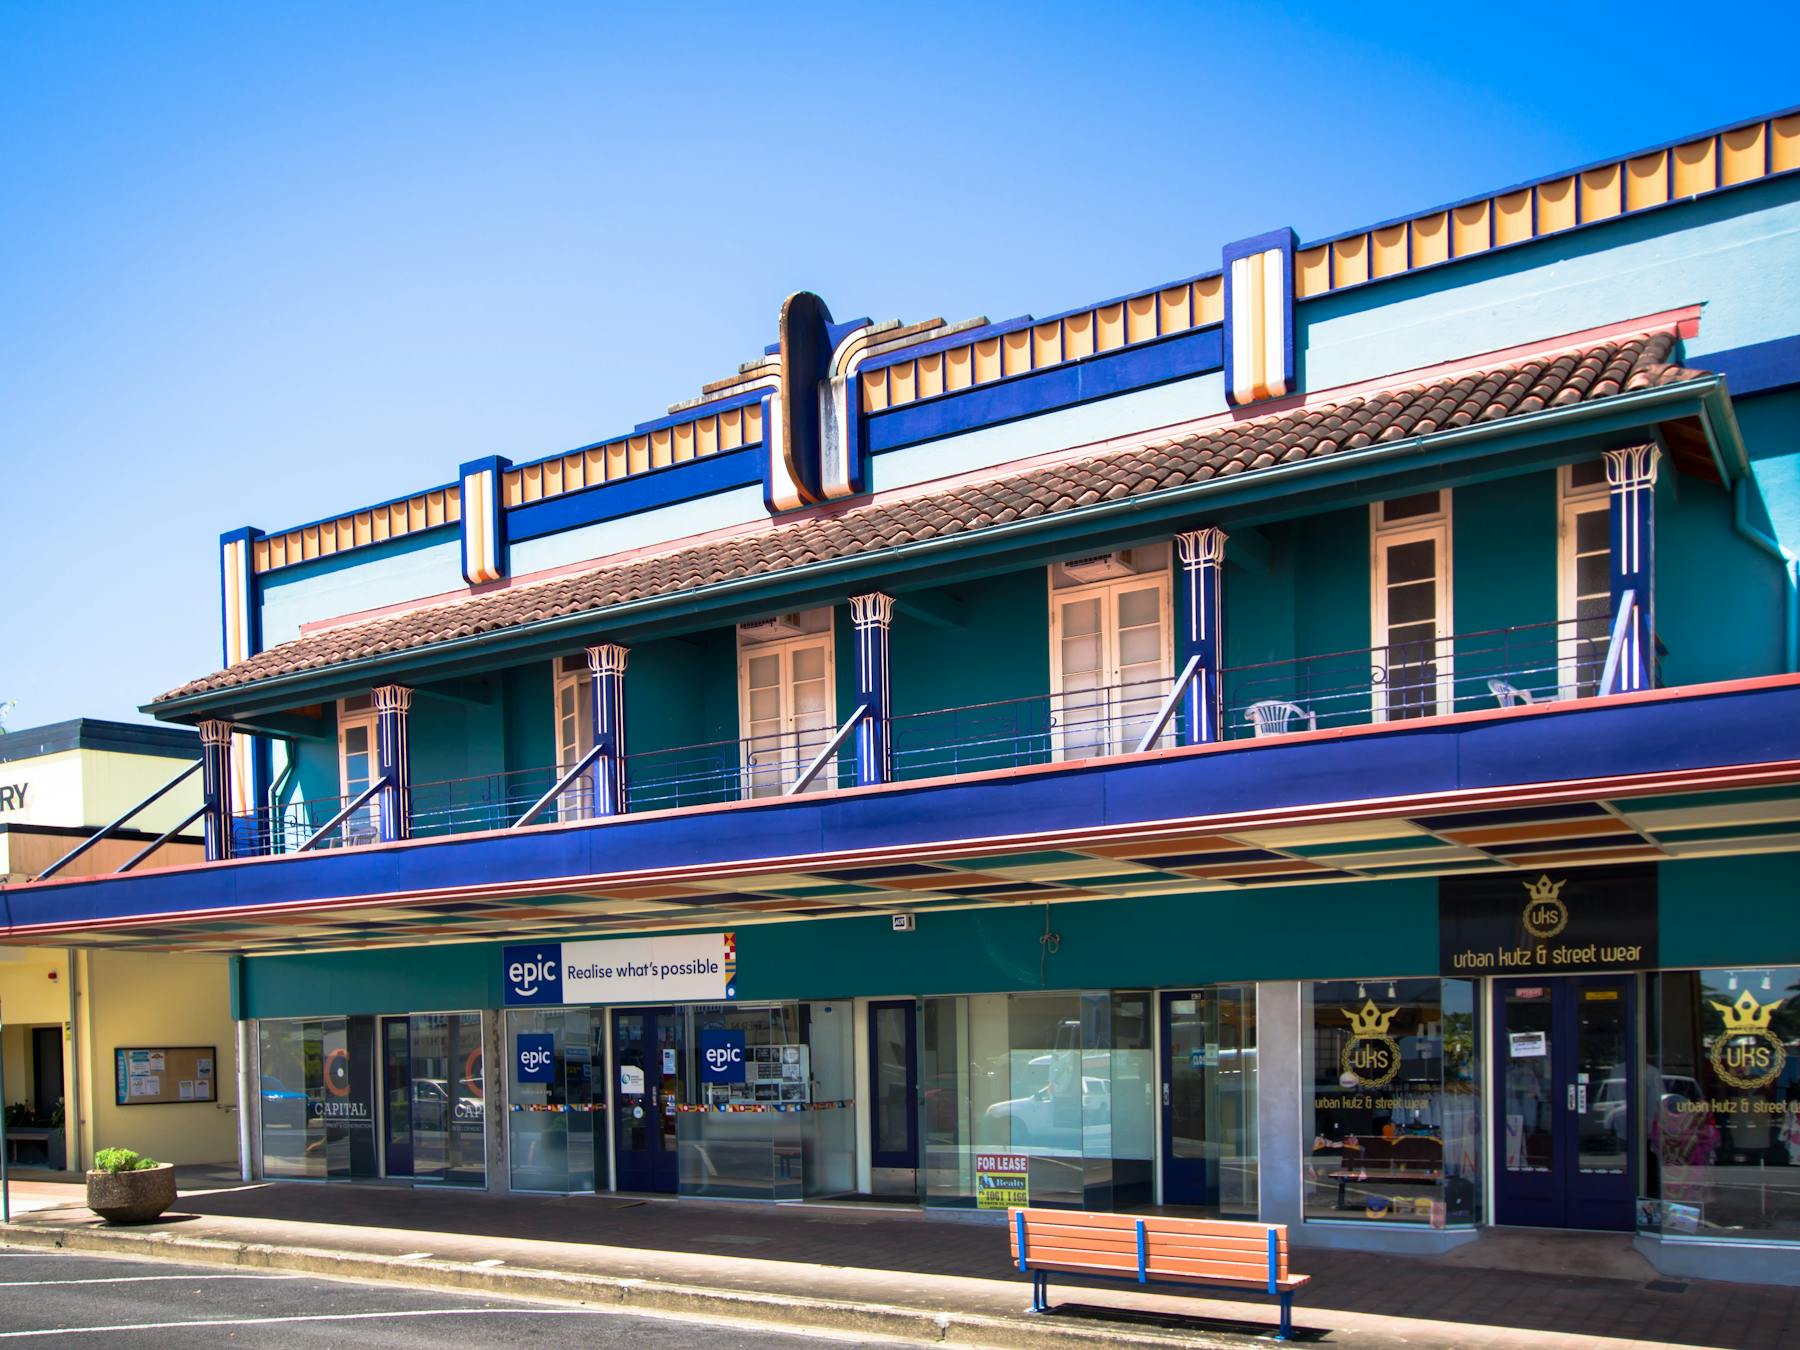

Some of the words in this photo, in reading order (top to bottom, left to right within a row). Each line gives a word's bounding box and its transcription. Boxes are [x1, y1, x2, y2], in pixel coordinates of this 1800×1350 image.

[1532, 906, 1559, 924] uks
[1453, 950, 1494, 968] urban
[1499, 947, 1532, 966] kutz
[1536, 945, 1546, 965] &
[1552, 944, 1597, 964] street
[1600, 945, 1642, 962] wear
[509, 954, 557, 988] epic
[567, 963, 613, 980] Realise
[616, 962, 658, 977] what's
[661, 958, 719, 979] possible
[520, 1046, 551, 1068] epic
[706, 1043, 741, 1066] epic
[1354, 1043, 1388, 1068] uks
[1727, 1041, 1770, 1067] uks
[314, 1102, 367, 1116] CAPITAL
[1315, 1097, 1341, 1109] urban
[1342, 1096, 1363, 1109] kutz
[1365, 1096, 1372, 1109] &
[1375, 1096, 1401, 1109] street
[1676, 1100, 1709, 1112] urban
[1711, 1098, 1738, 1113] kutz
[1741, 1098, 1749, 1112] &
[1753, 1099, 1787, 1113] street
[977, 1156, 995, 1170] FOR
[997, 1156, 1027, 1171] LEASE
